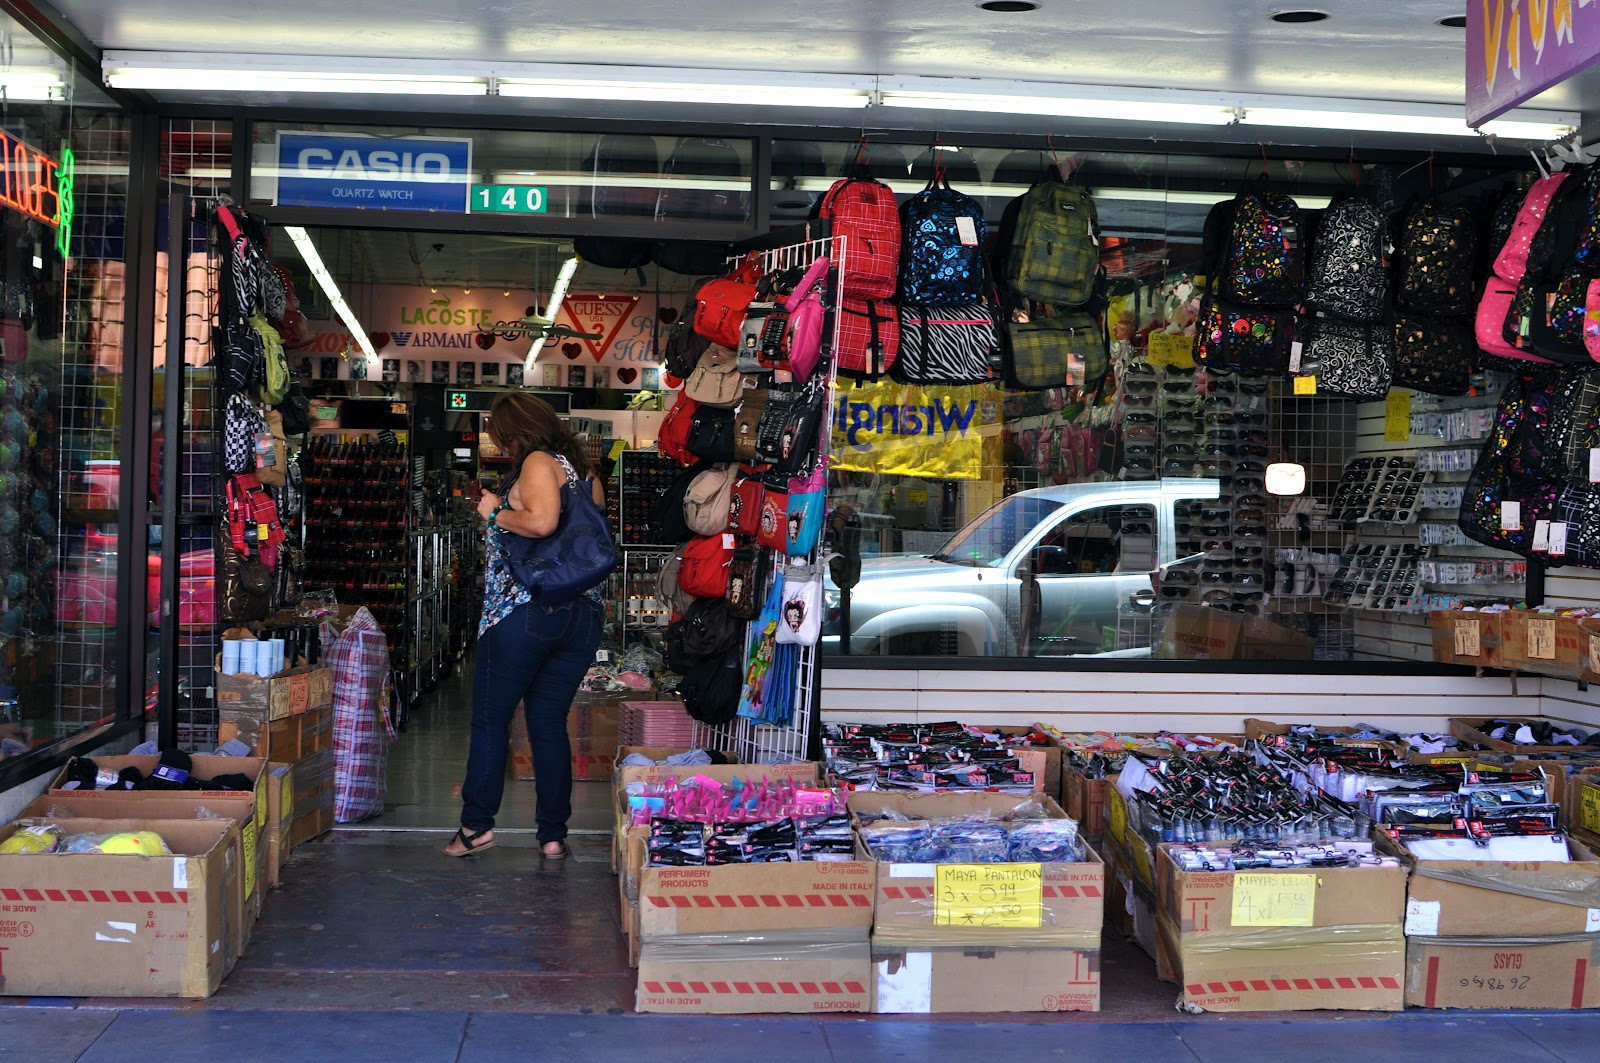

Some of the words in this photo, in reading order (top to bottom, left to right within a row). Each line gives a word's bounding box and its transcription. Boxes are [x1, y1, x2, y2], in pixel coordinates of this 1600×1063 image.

[297, 148, 451, 184] CASIO
[331, 187, 375, 199] QUARTZ
[378, 189, 413, 200] WATCH
[574, 302, 623, 317] GUESS
[401, 307, 492, 327] LACOSTE
[411, 332, 473, 348] ARMANI
[658, 869, 711, 879] PERFUMERY
[945, 869, 977, 881] MAYA
[984, 867, 1042, 881] PANTALON
[1239, 876, 1279, 886] MAYAS
[660, 879, 709, 888] PRODUCTS
[850, 882, 874, 890] ITALY
[942, 885, 955, 903] 3
[1238, 895, 1257, 922] 4
[1493, 953, 1522, 969] GLASS
[813, 1001, 861, 1009] PRODUCTS
[1217, 996, 1240, 1004] MADE
